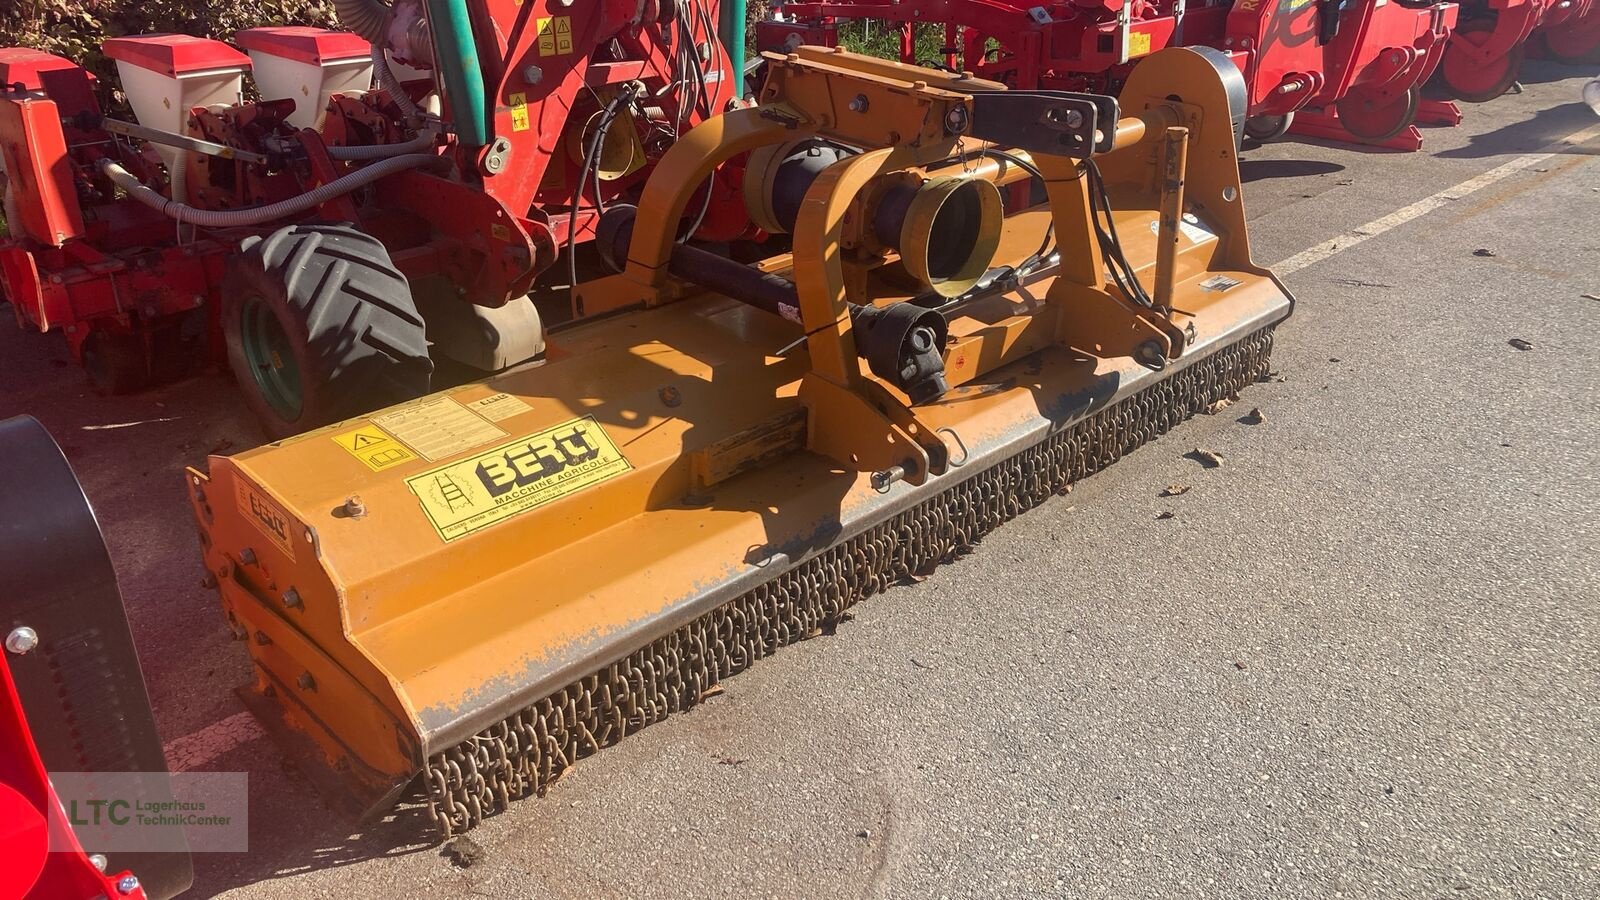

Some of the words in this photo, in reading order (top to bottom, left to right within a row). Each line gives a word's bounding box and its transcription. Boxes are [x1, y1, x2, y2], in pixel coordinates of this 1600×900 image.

[475, 423, 600, 498] BERTI
[494, 478, 554, 505] MACCHINE
[557, 455, 610, 481] AGRICOLE
